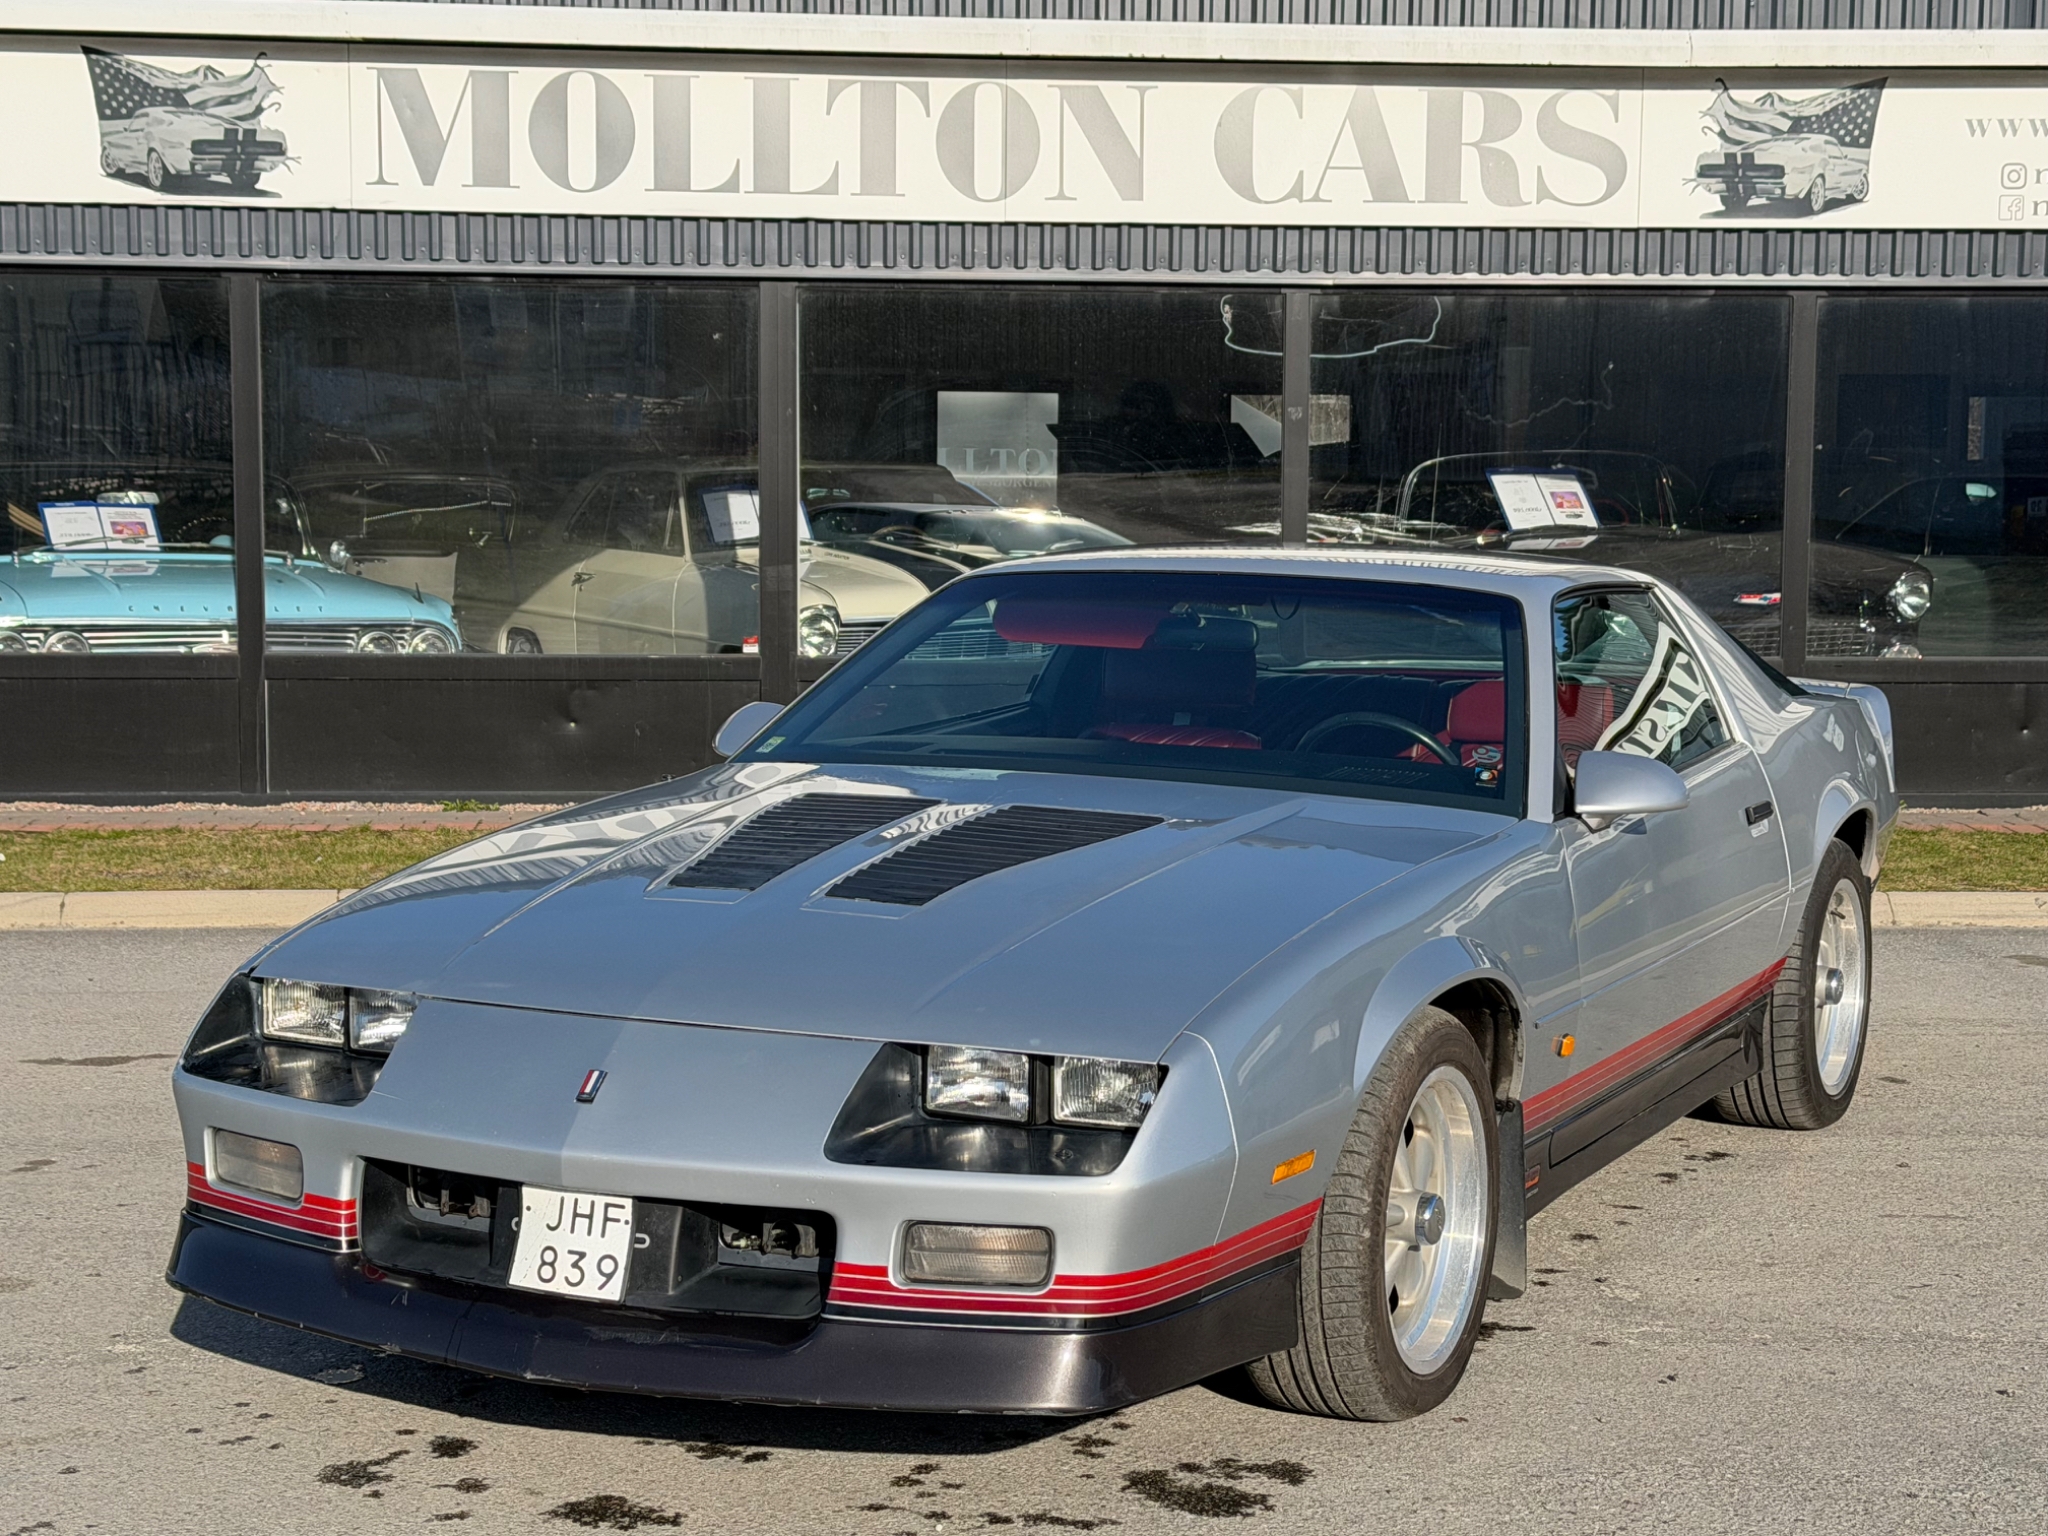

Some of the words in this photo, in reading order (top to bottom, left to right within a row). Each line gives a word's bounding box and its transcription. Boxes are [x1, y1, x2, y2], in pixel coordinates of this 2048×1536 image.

[366, 66, 1159, 203] MOLLTON
[1213, 84, 1628, 207] CARS
[545, 1195, 627, 1239] JHF
[536, 1245, 619, 1291] 839
